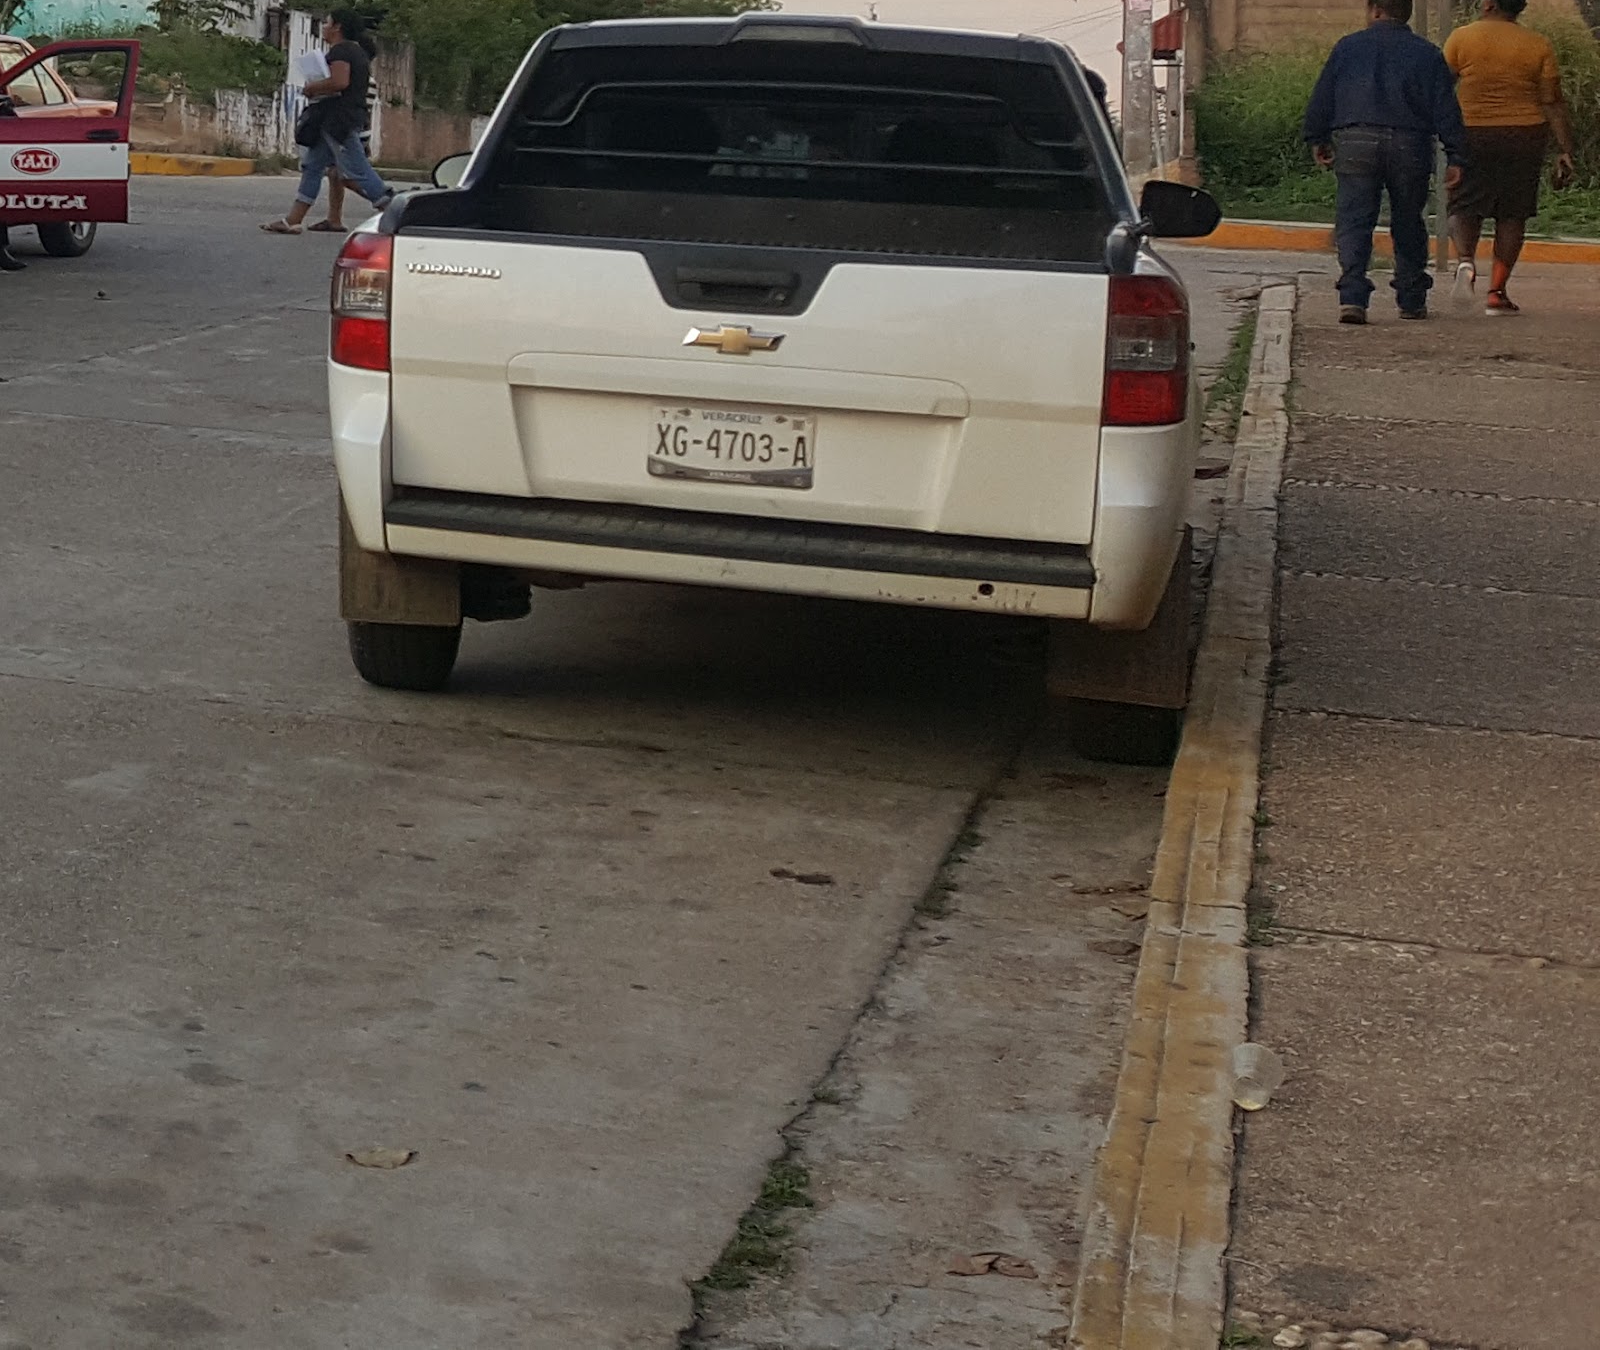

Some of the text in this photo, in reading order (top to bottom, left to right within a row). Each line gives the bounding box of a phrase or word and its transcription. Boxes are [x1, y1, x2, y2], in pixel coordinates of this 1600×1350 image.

[16, 153, 54, 169] TAXI
[702, 411, 762, 424] VERACRUZ
[655, 423, 807, 467] XG-4703-A
